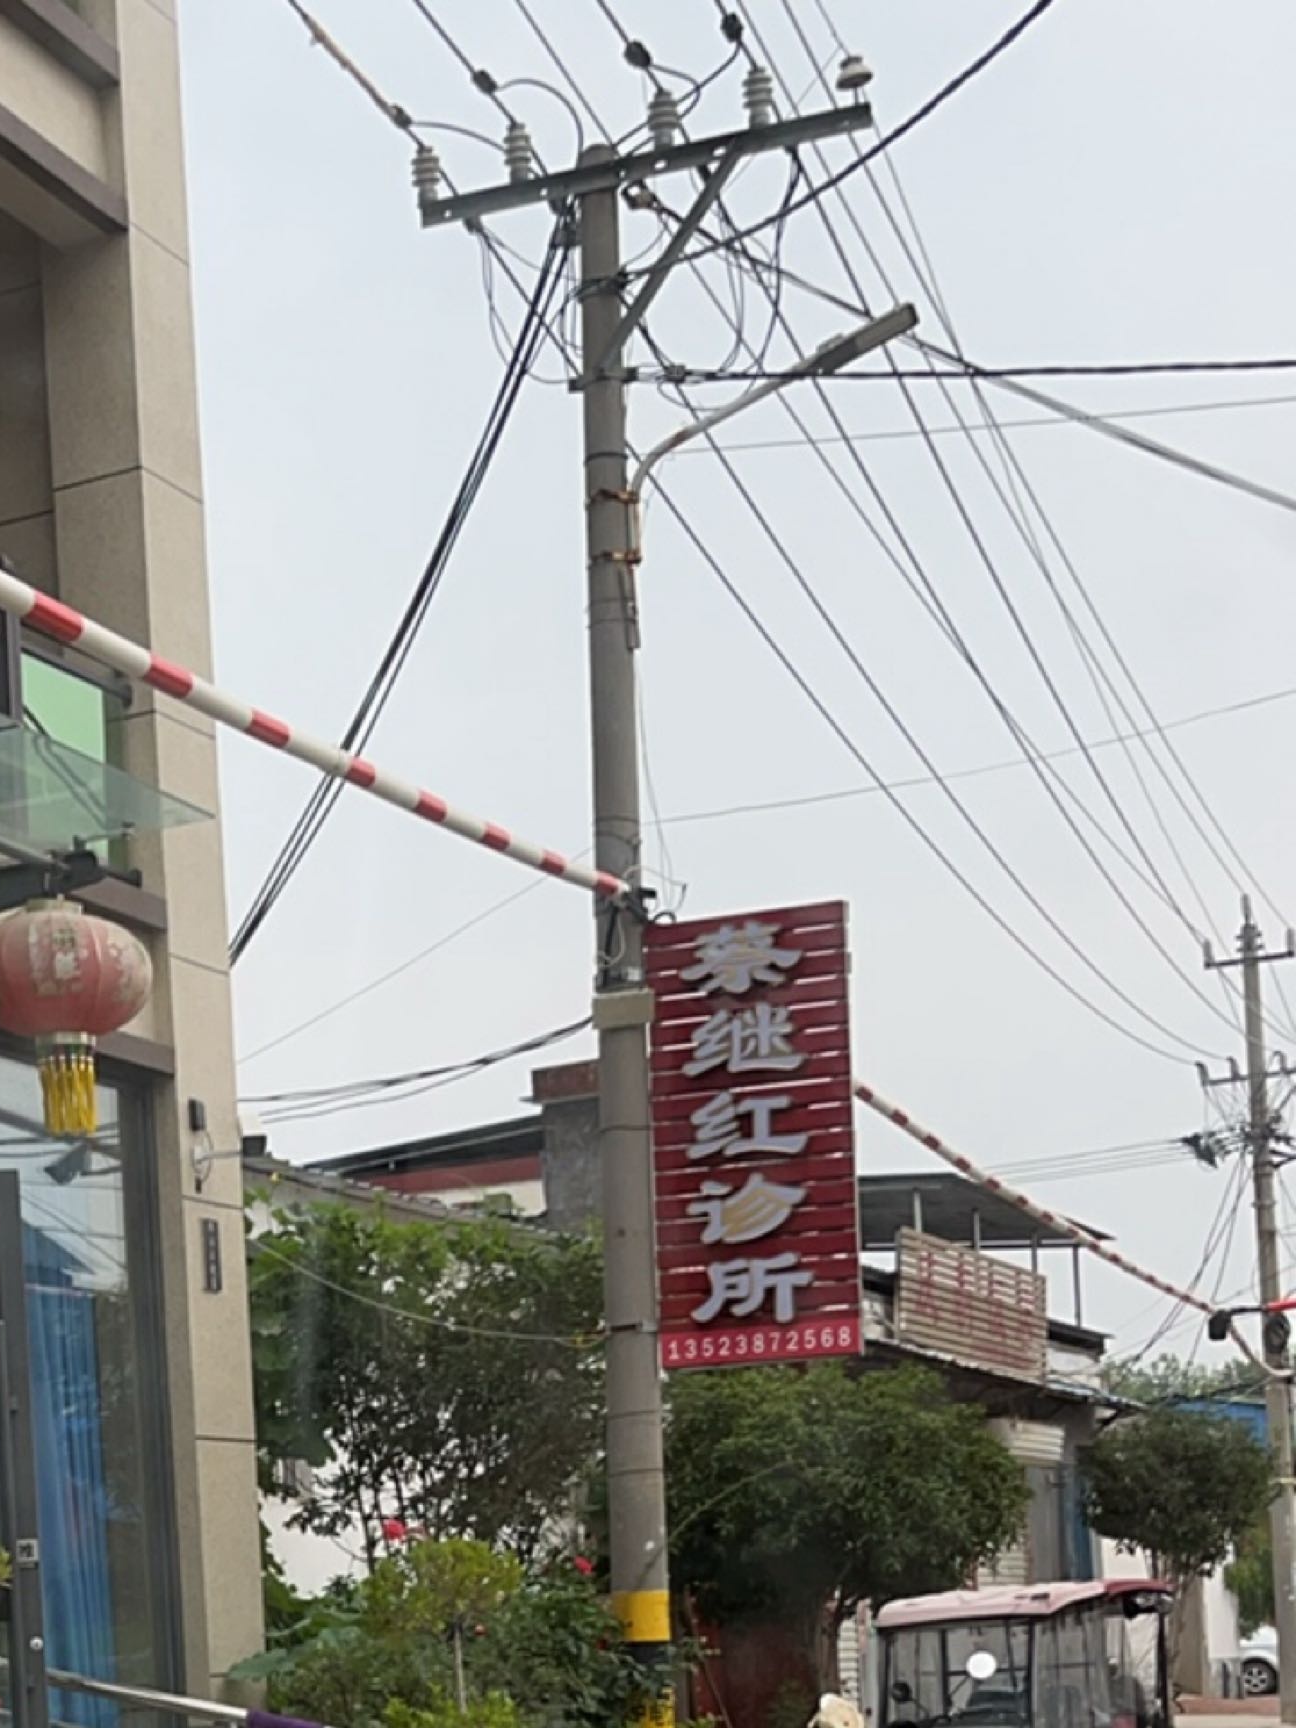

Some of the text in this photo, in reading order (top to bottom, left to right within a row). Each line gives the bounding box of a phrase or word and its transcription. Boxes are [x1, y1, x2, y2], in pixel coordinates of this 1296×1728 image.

[680, 920, 814, 1324] 蔡继红诊所
[667, 1325, 851, 1361] 13523872568
